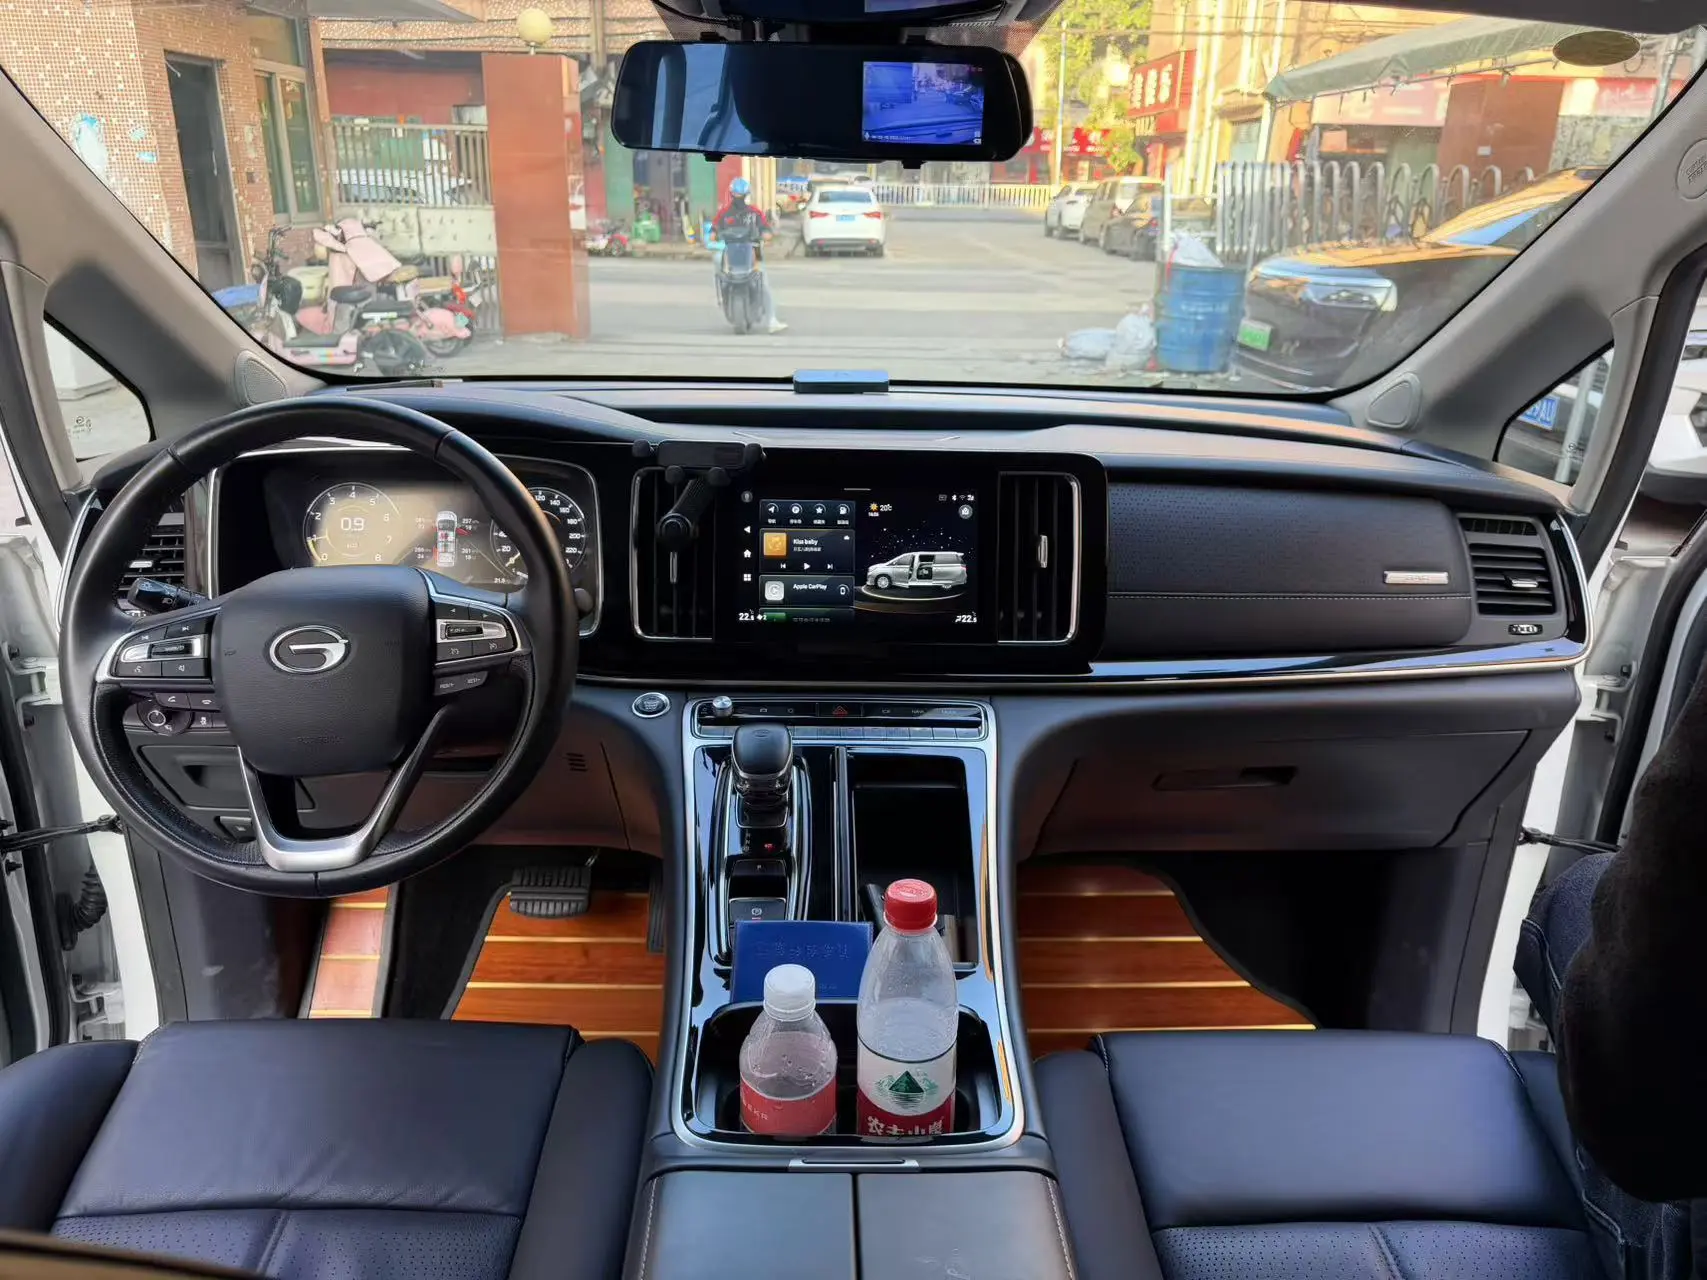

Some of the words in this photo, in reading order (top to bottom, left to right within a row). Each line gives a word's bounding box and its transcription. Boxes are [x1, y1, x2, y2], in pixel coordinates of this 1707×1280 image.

[329, 497, 336, 505] 3
[369, 498, 376, 506] 5
[315, 512, 321, 520] 2
[321, 552, 328, 561] 0
